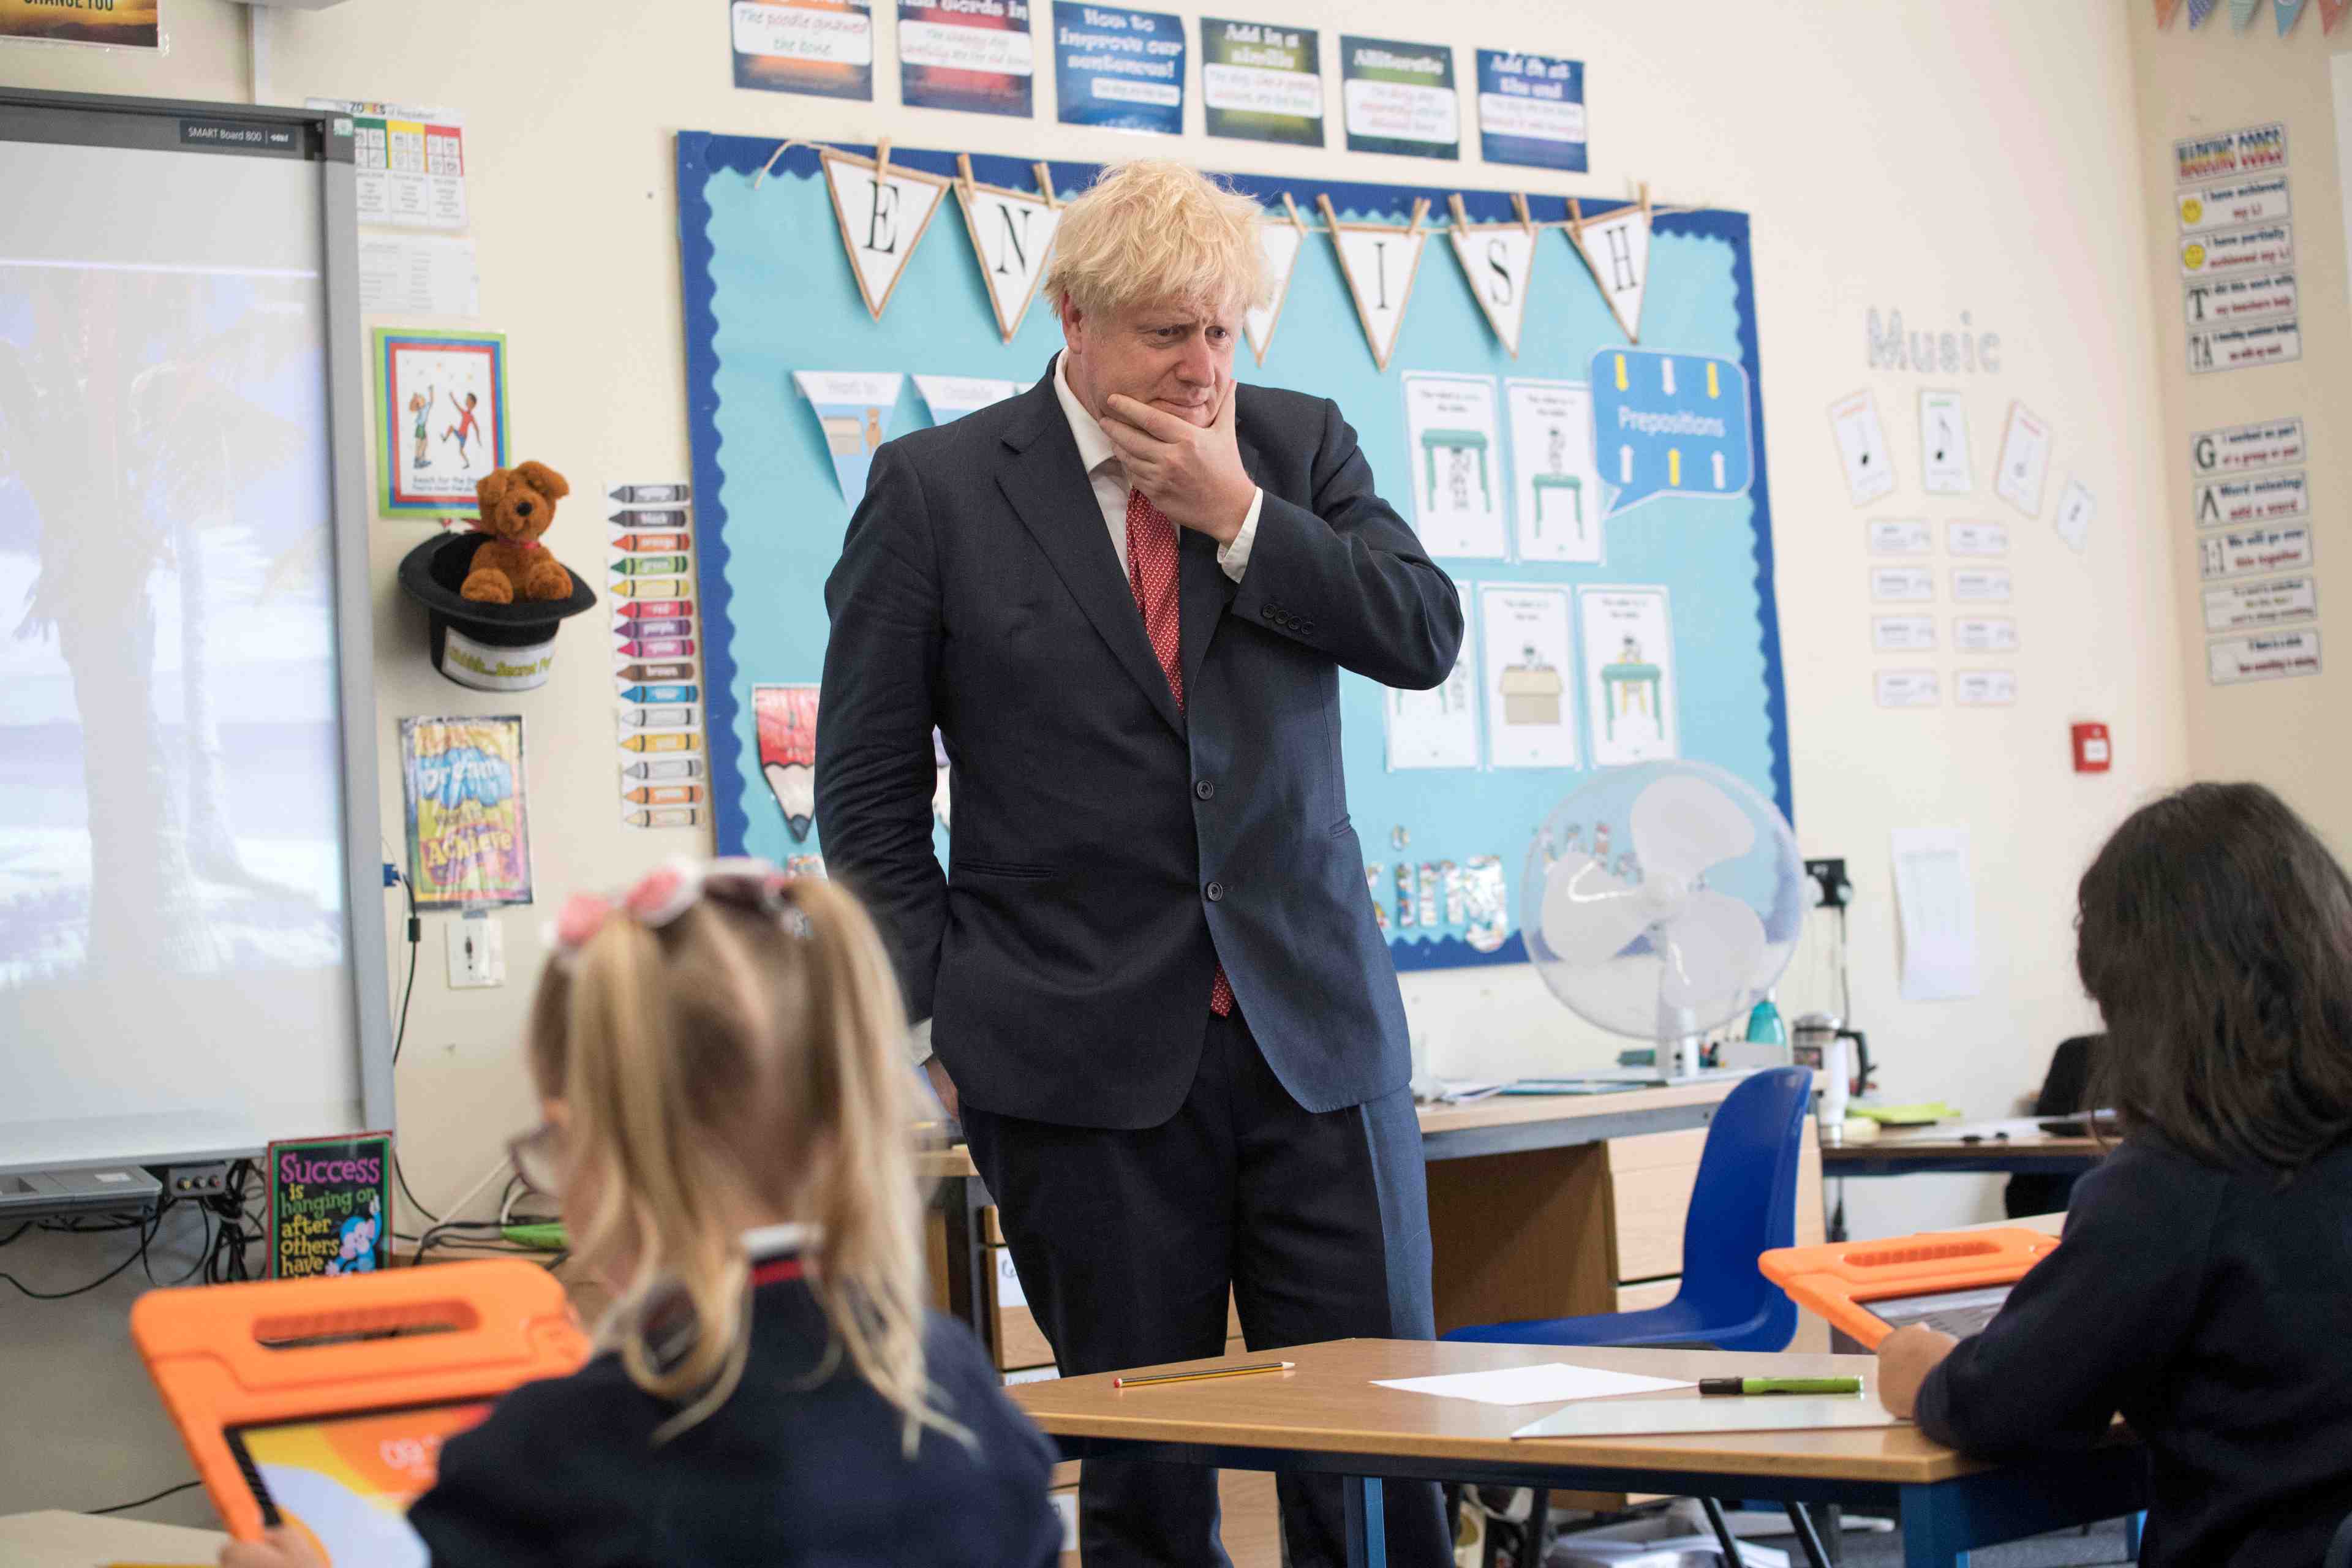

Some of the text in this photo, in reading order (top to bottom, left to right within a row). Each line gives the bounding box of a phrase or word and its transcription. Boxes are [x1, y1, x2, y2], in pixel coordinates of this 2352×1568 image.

[23, 0, 83, 9] ANGE
[1084, 9, 1155, 32] How to
[187, 126, 218, 139] SMART
[220, 129, 244, 141] Board
[245, 130, 262, 142] 800
[2189, 287, 2210, 320] T
[1867, 304, 2002, 374] Music
[1618, 404, 1725, 439] Prepositions
[2196, 436, 2216, 470] G
[280, 1152, 380, 1185] Success
[280, 1186, 377, 1219] hanging on
[288, 1182, 305, 1201] is
[281, 1214, 333, 1238] after
[280, 1235, 341, 1257] others
[281, 1254, 325, 1276] have
